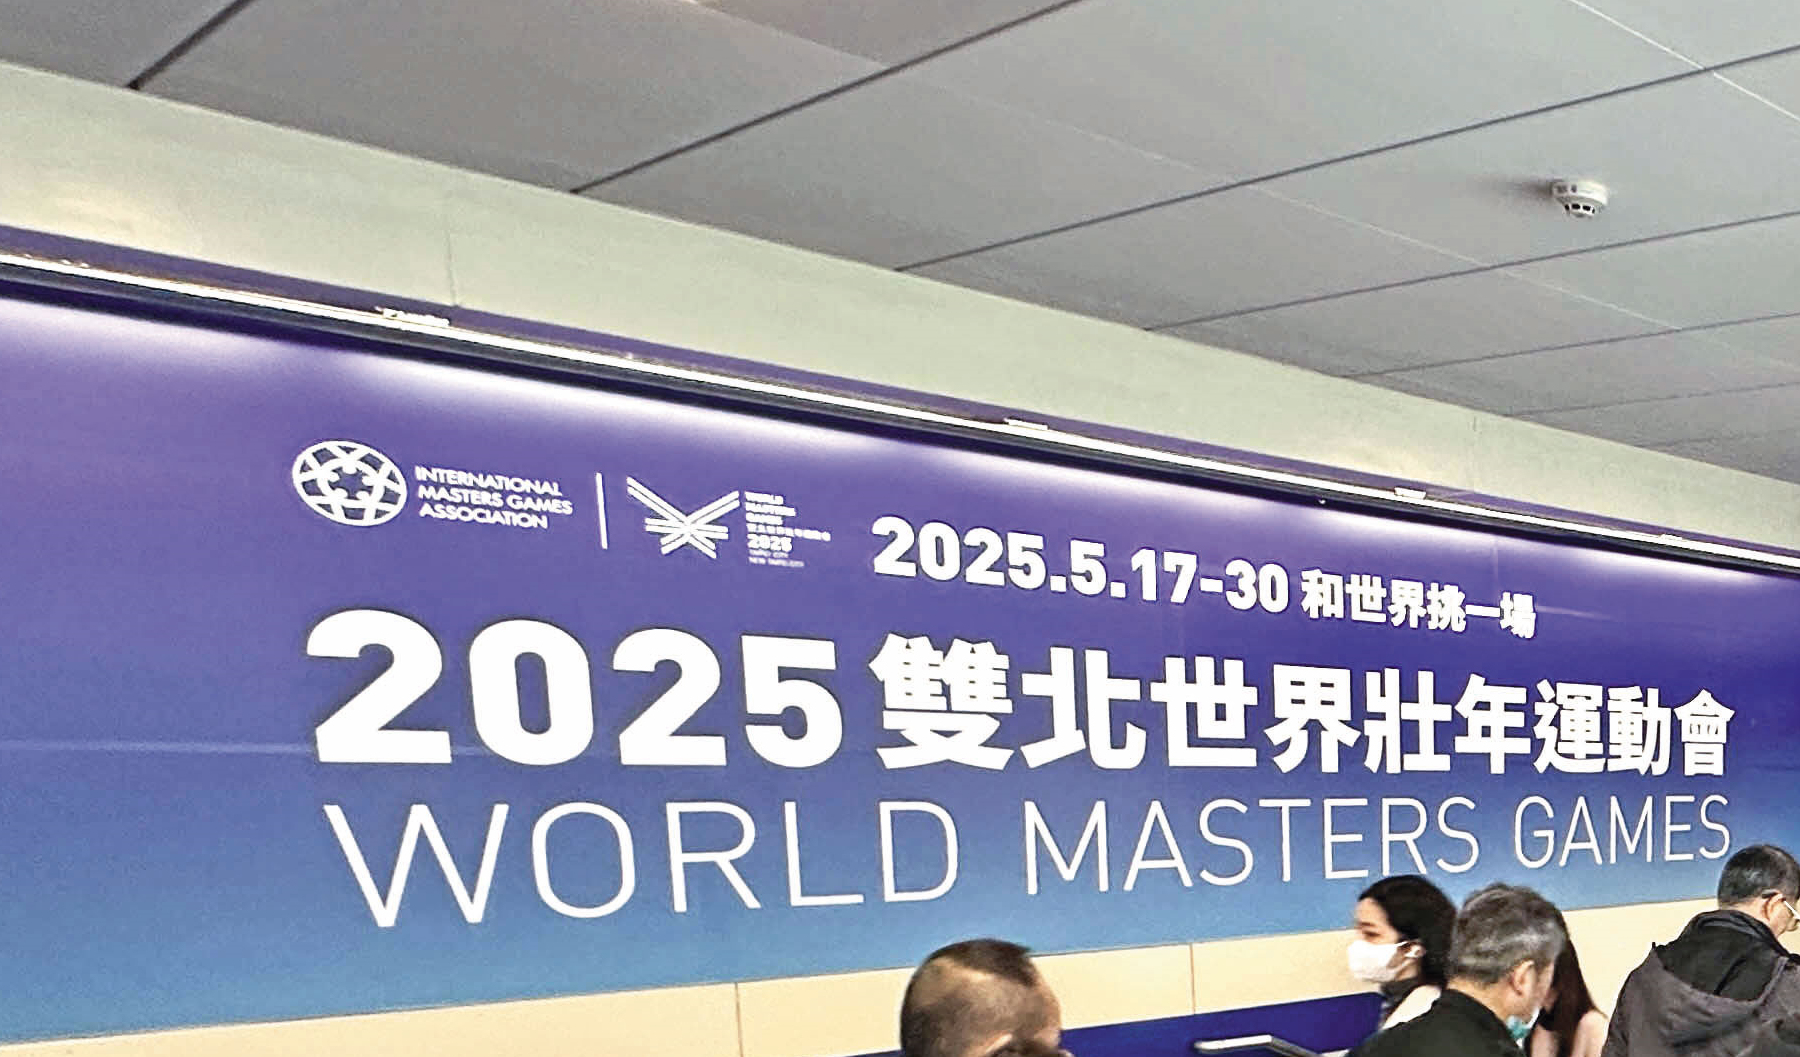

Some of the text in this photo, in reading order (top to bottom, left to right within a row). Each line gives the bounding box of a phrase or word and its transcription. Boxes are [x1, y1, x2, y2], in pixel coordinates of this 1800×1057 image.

[414, 466, 563, 496] INTERNATIONAL
[418, 485, 573, 515] MASTERS GAMES
[419, 503, 548, 529] ASSOCIATION
[747, 534, 793, 553] 2025
[872, 516, 1536, 639] 2025.5.17-30 和世界挑一場
[307, 609, 1735, 776] 2025 雙北世界壯年運動會
[323, 794, 1732, 928] WORLD MASTERS GAMES
